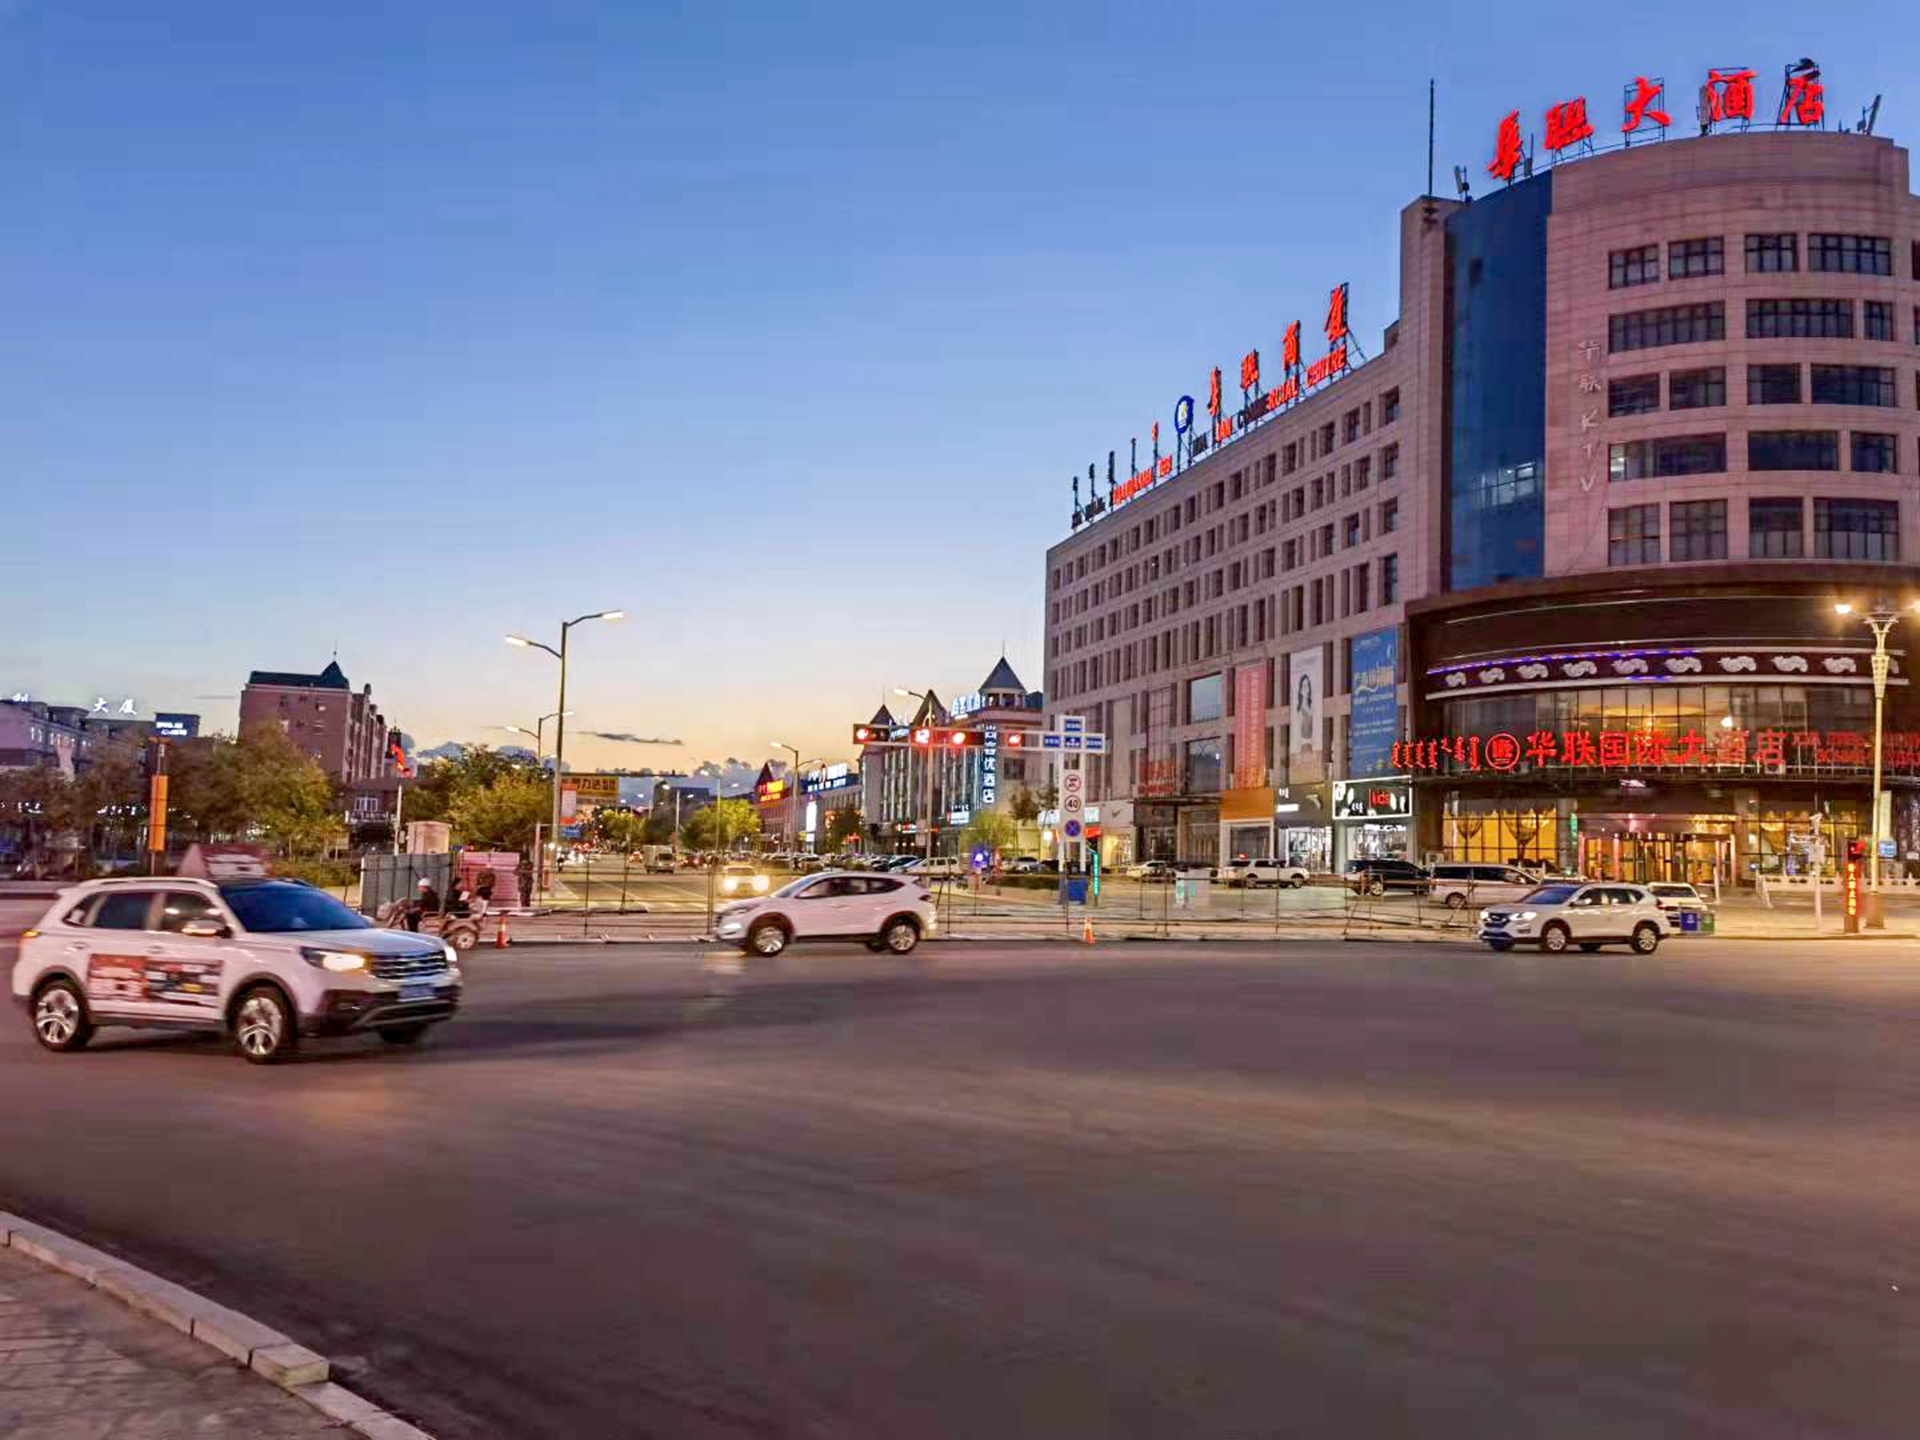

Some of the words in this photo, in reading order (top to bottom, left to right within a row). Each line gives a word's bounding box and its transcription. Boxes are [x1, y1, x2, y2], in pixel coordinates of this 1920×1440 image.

[1305, 345, 1347, 387] CENTRE
[1525, 726, 1788, 768] 华联国际大酒店
[1067, 799, 1079, 809] 40
